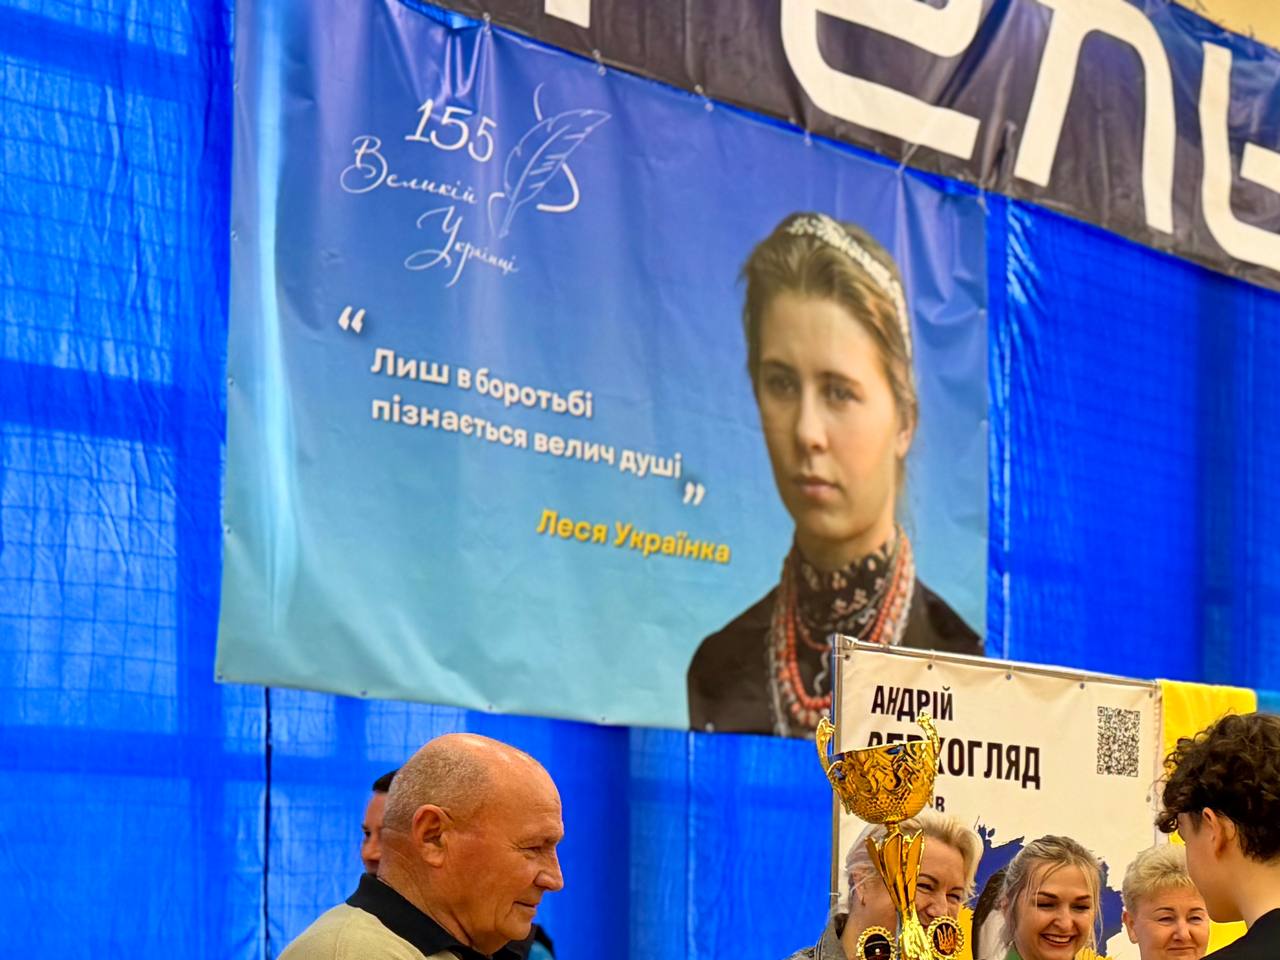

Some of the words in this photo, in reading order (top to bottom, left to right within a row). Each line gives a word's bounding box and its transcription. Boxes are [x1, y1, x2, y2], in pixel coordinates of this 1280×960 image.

[405, 98, 497, 162] 155
[370, 347, 450, 385] Лиш
[456, 369, 472, 390] в
[475, 368, 593, 418] боротьбі
[371, 395, 528, 449] пізнається
[533, 433, 615, 465] велич
[618, 453, 683, 480] душі
[536, 509, 608, 543] Леся
[612, 521, 732, 564] Українка
[870, 684, 954, 723] АНДРІЙ
